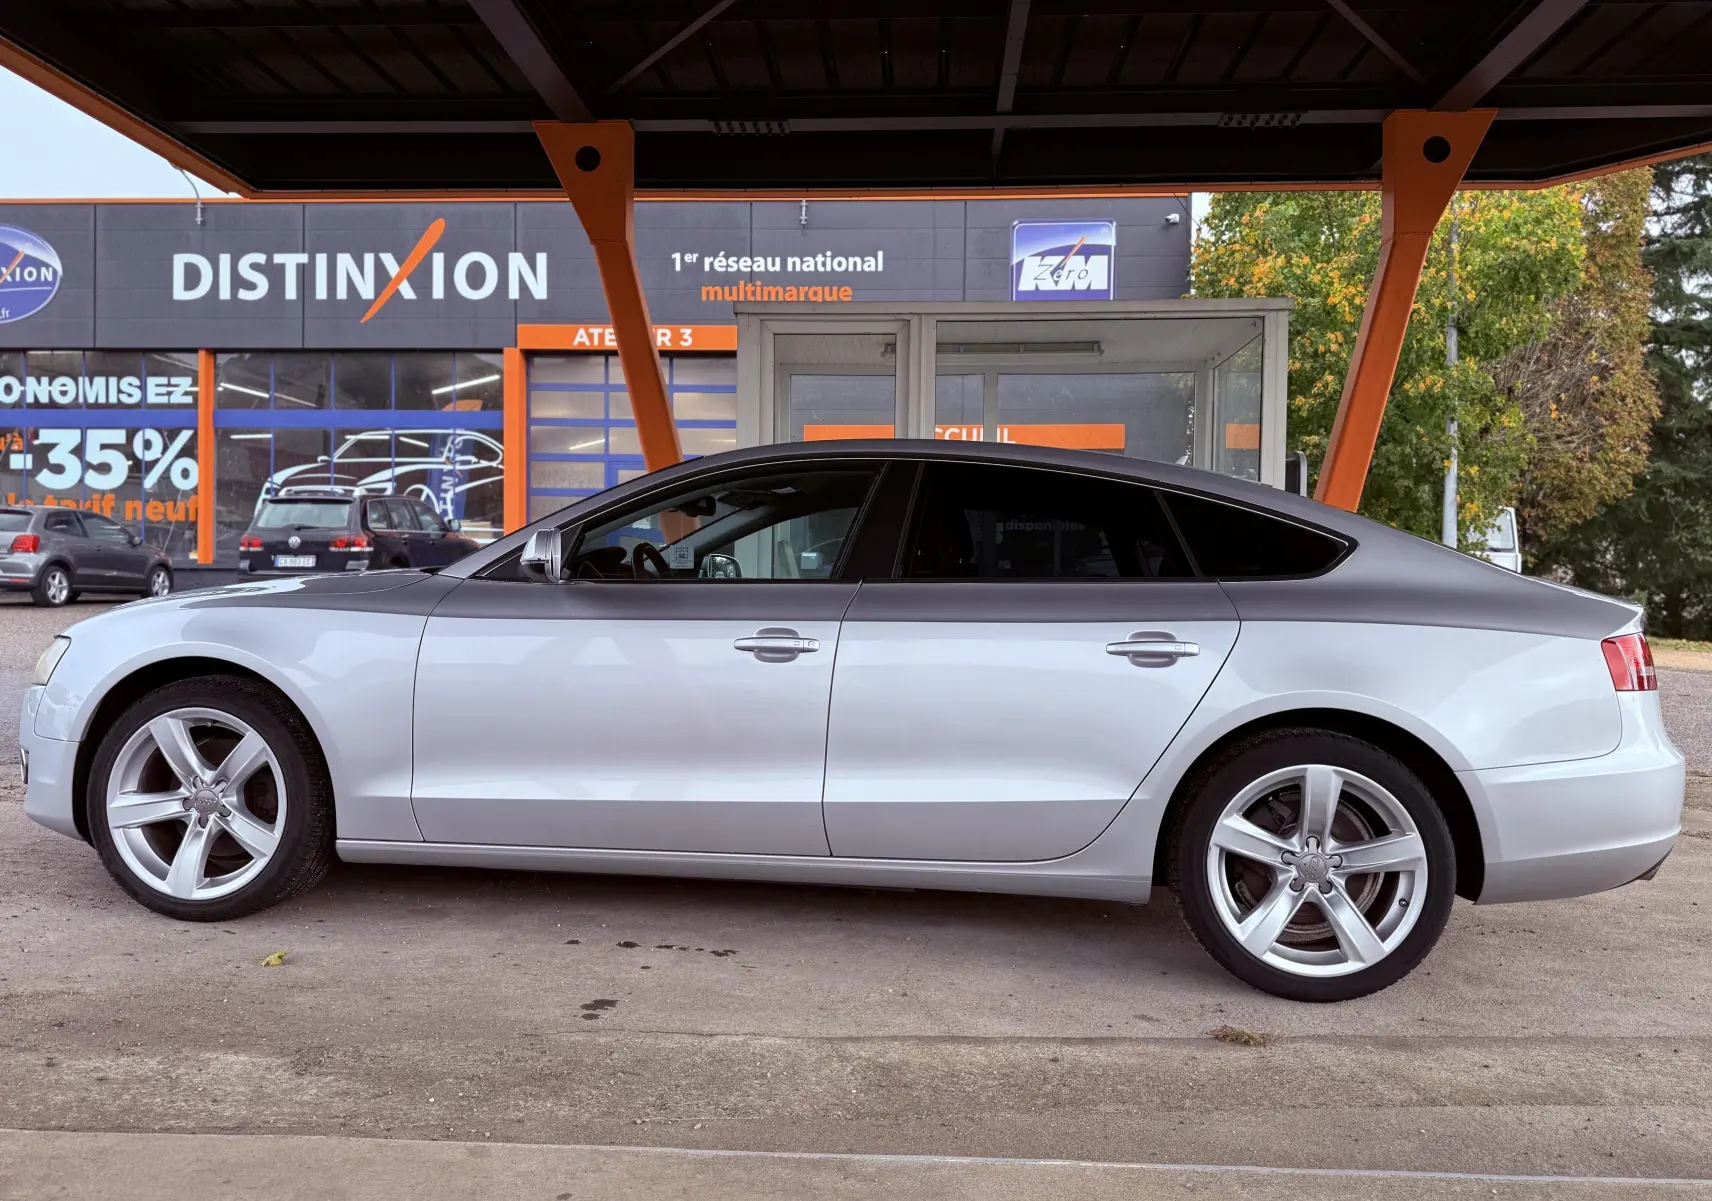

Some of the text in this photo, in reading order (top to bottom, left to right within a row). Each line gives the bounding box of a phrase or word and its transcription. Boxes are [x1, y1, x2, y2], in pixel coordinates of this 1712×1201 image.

[671, 251, 884, 272] 1er réseau national
[701, 280, 853, 302] multimarque
[680, 328, 693, 347] 3
[9, 428, 199, 490] -35%
[125, 494, 198, 521] neuf
